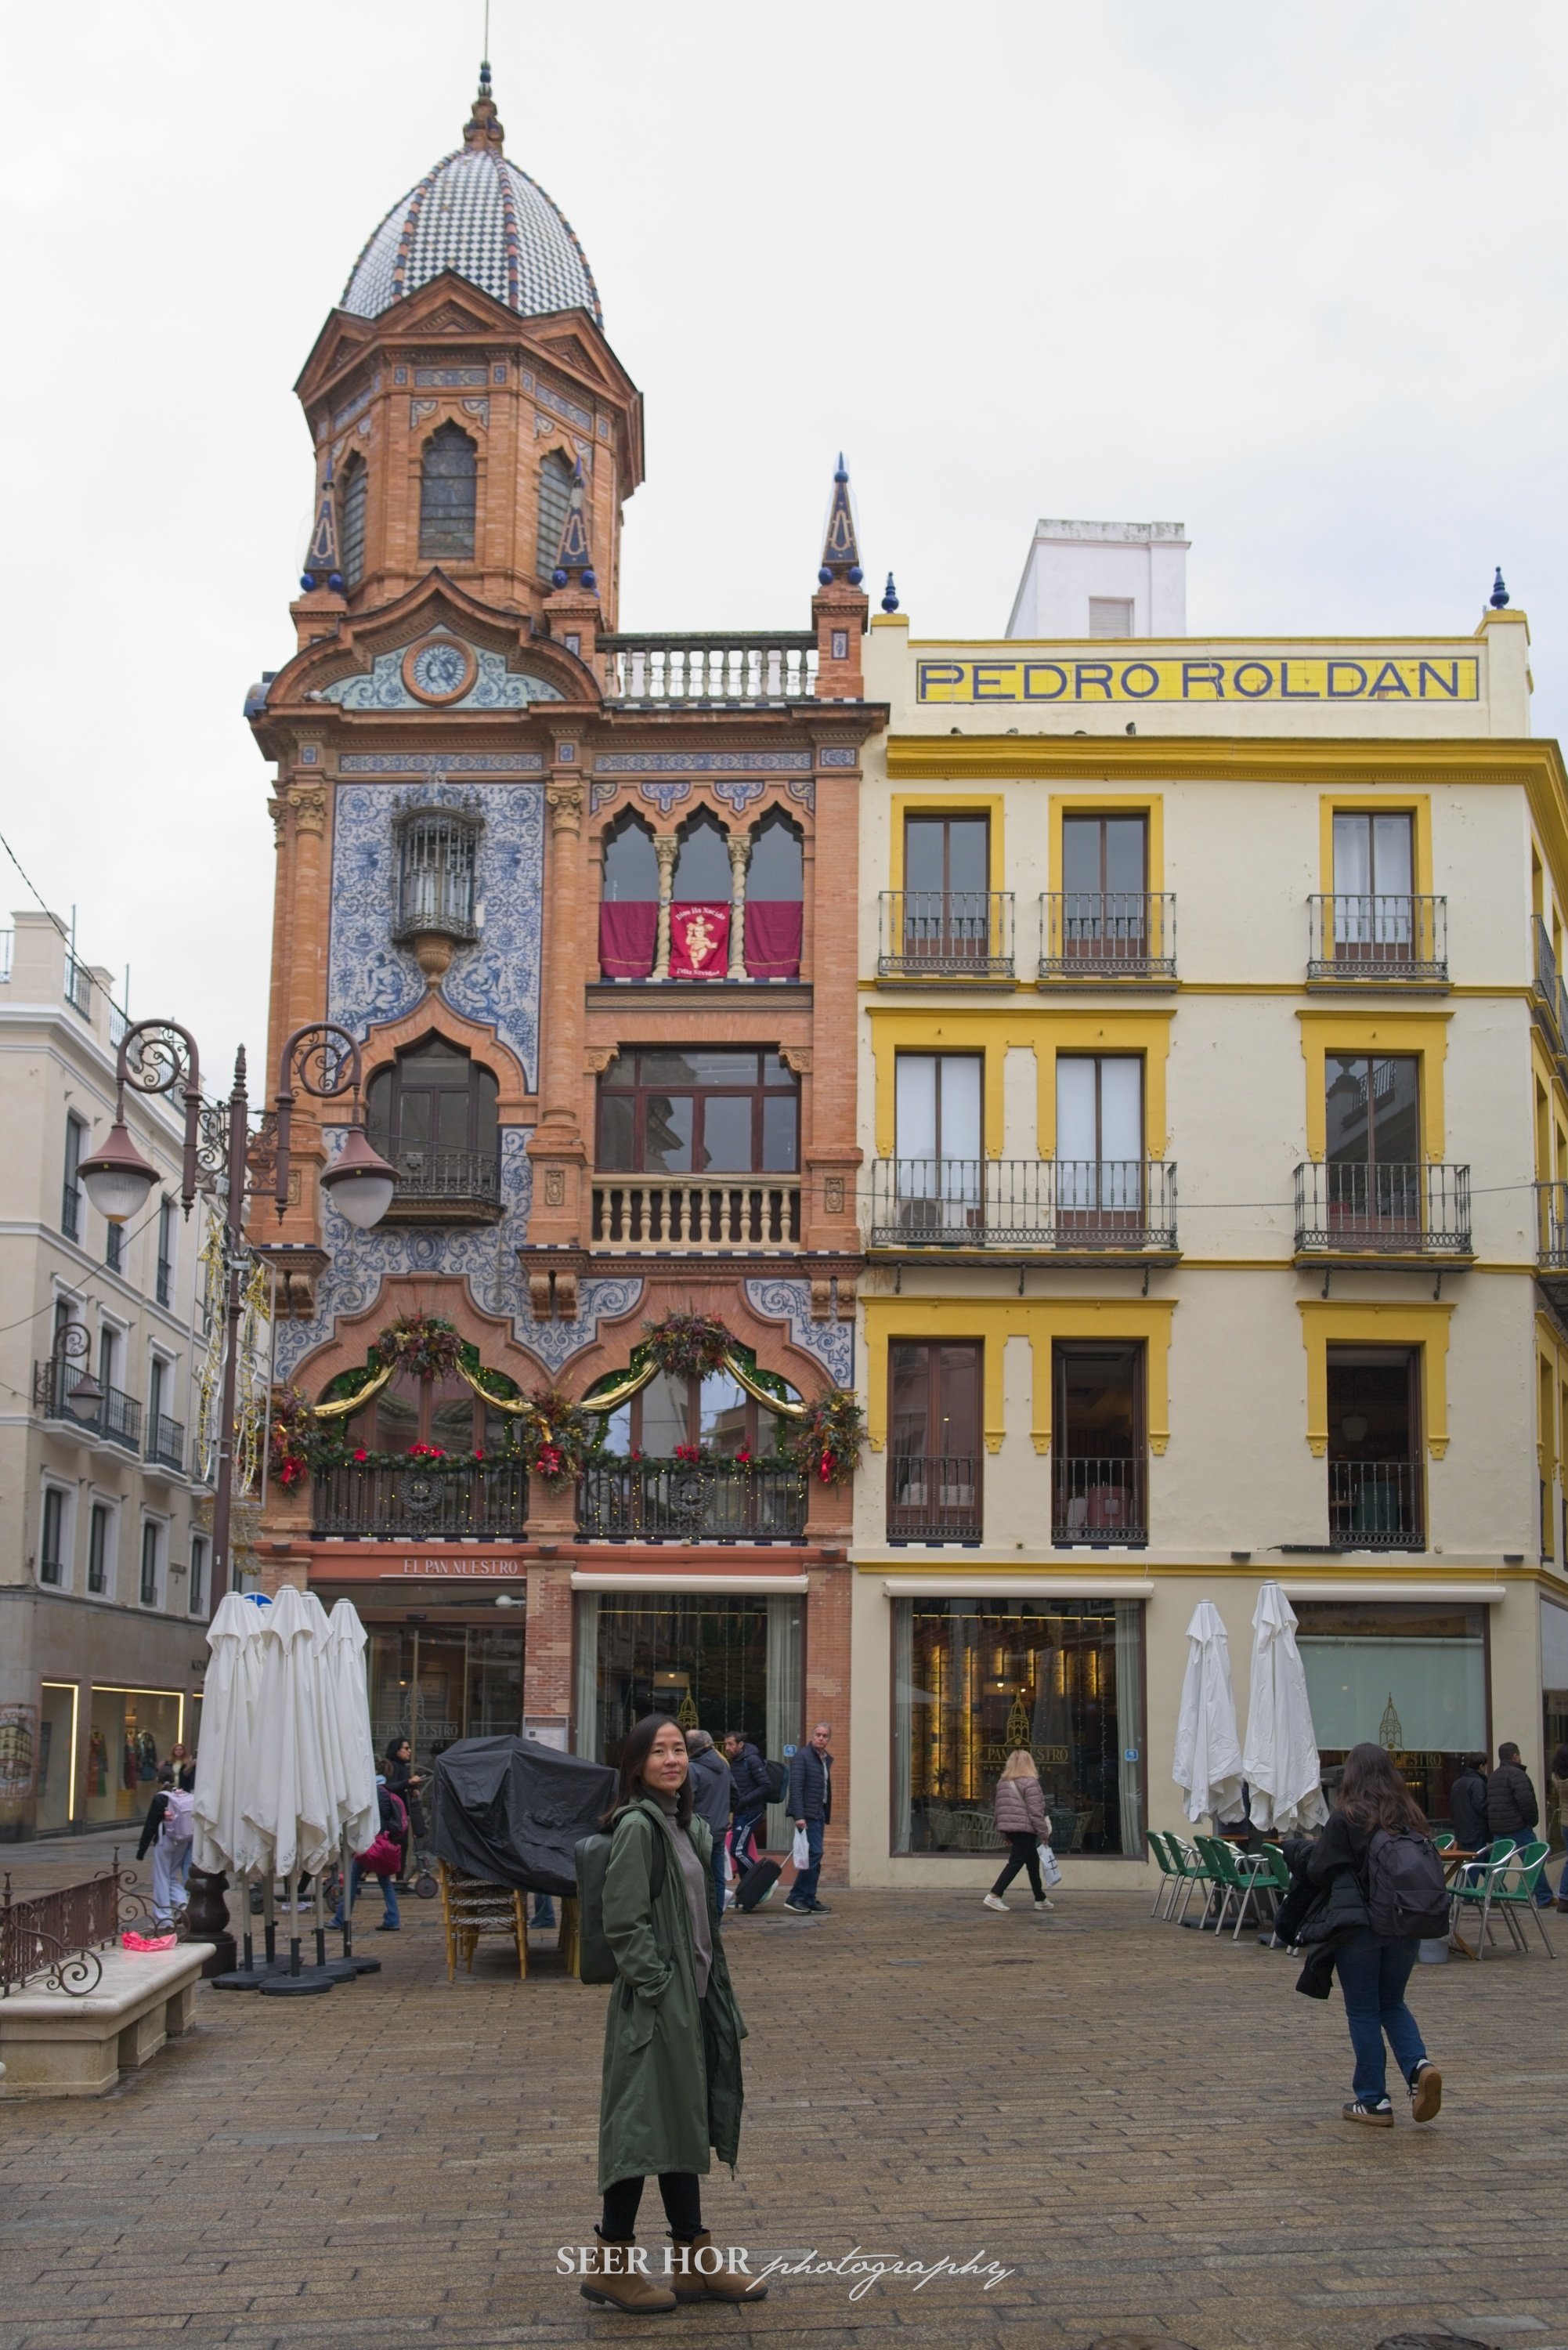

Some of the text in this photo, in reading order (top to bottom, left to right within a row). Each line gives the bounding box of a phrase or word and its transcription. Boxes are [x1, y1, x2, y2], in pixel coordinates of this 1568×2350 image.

[919, 660, 1459, 701] PEDRO ROLDAN
[403, 1559, 518, 1575] EL PAN NUESTRO
